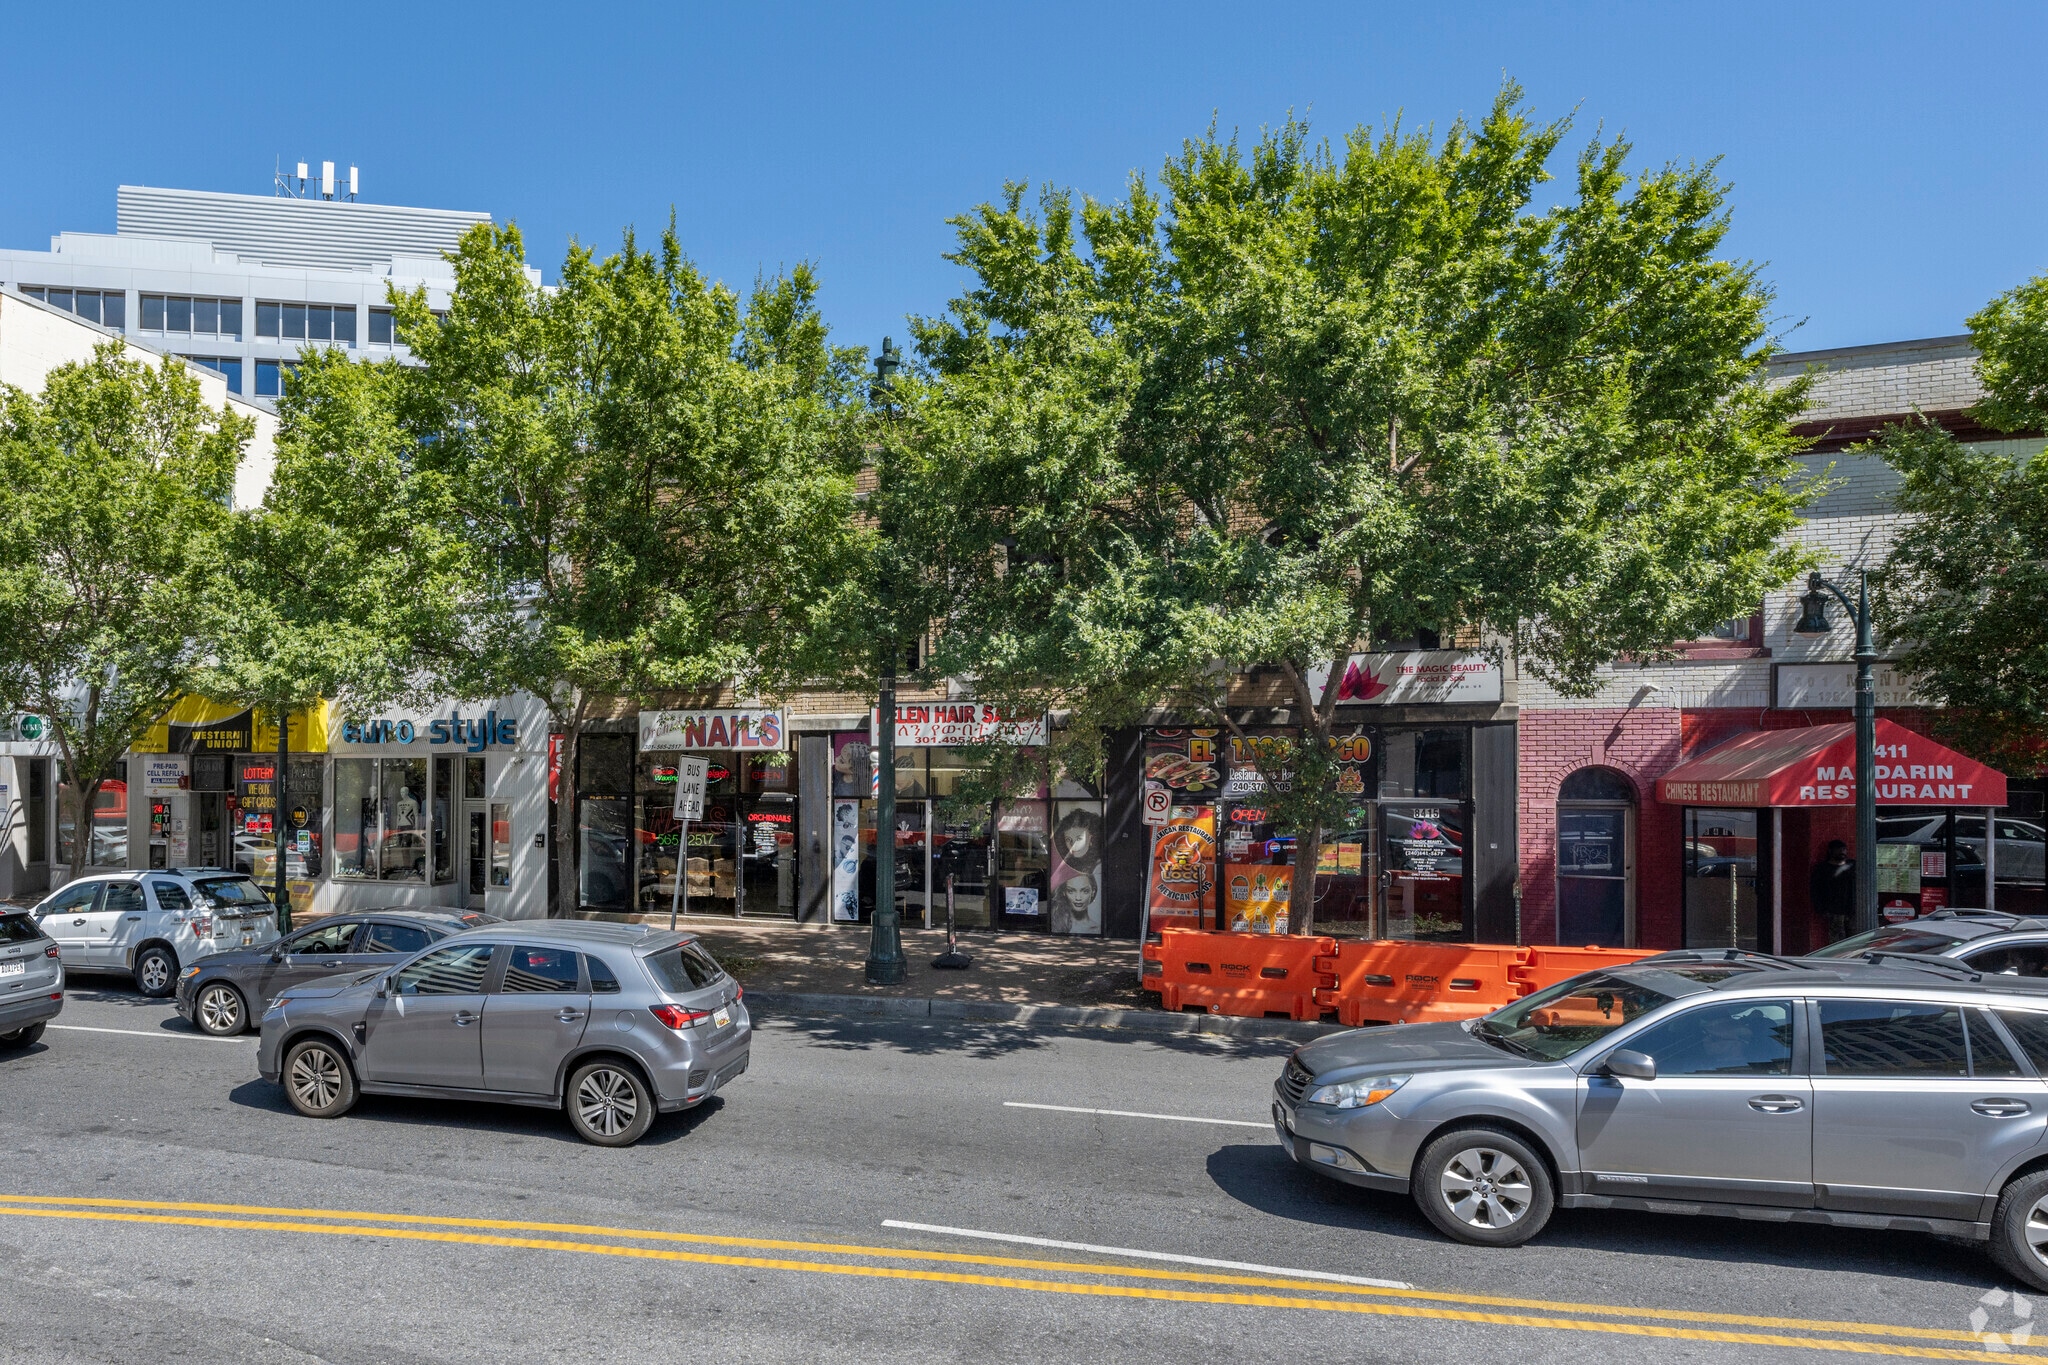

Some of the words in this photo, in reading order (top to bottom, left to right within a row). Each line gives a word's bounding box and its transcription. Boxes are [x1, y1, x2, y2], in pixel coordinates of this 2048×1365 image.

[1396, 665, 1414, 674] THE
[1416, 664, 1449, 673] MAGIC
[1451, 663, 1488, 672] BEAUTY
[1416, 675, 1440, 683] Facial
[1449, 675, 1466, 683] Spa
[876, 705, 930, 724] LEN
[934, 705, 976, 723] HAIR
[192, 731, 241, 740] WESTERN
[342, 719, 415, 745] euro
[429, 710, 516, 753] style
[685, 714, 781, 748] NAILS
[206, 740, 241, 748] UNION
[1189, 739, 1215, 763] EL
[1875, 744, 1908, 758] 411
[243, 768, 275, 780] LOTTERY
[686, 764, 700, 777] BUS
[706, 769, 731, 779] elash
[751, 771, 781, 780] OPEN
[1816, 765, 1954, 780] MADARIN
[248, 784, 258, 795] WE
[260, 784, 271, 795] BUY
[683, 782, 700, 795] LANE
[1665, 782, 1698, 801] CHINESE
[1701, 783, 1760, 803] RESTAURANT
[1800, 784, 1973, 800] RESURANT
[242, 797, 256, 808] GIFT
[256, 797, 277, 809] CARDS
[678, 800, 700, 813] AHEAD
[1231, 809, 1267, 821] OPEN
[1413, 809, 1439, 818] 8415
[657, 834, 679, 846] 565
[688, 834, 715, 846] 2517
[1156, 825, 1178, 841] EXICAN
[1178, 825, 1216, 845] RESTAURANT
[1158, 883, 1190, 901] MEXICAN
[1405, 974, 1439, 982] ROCK
